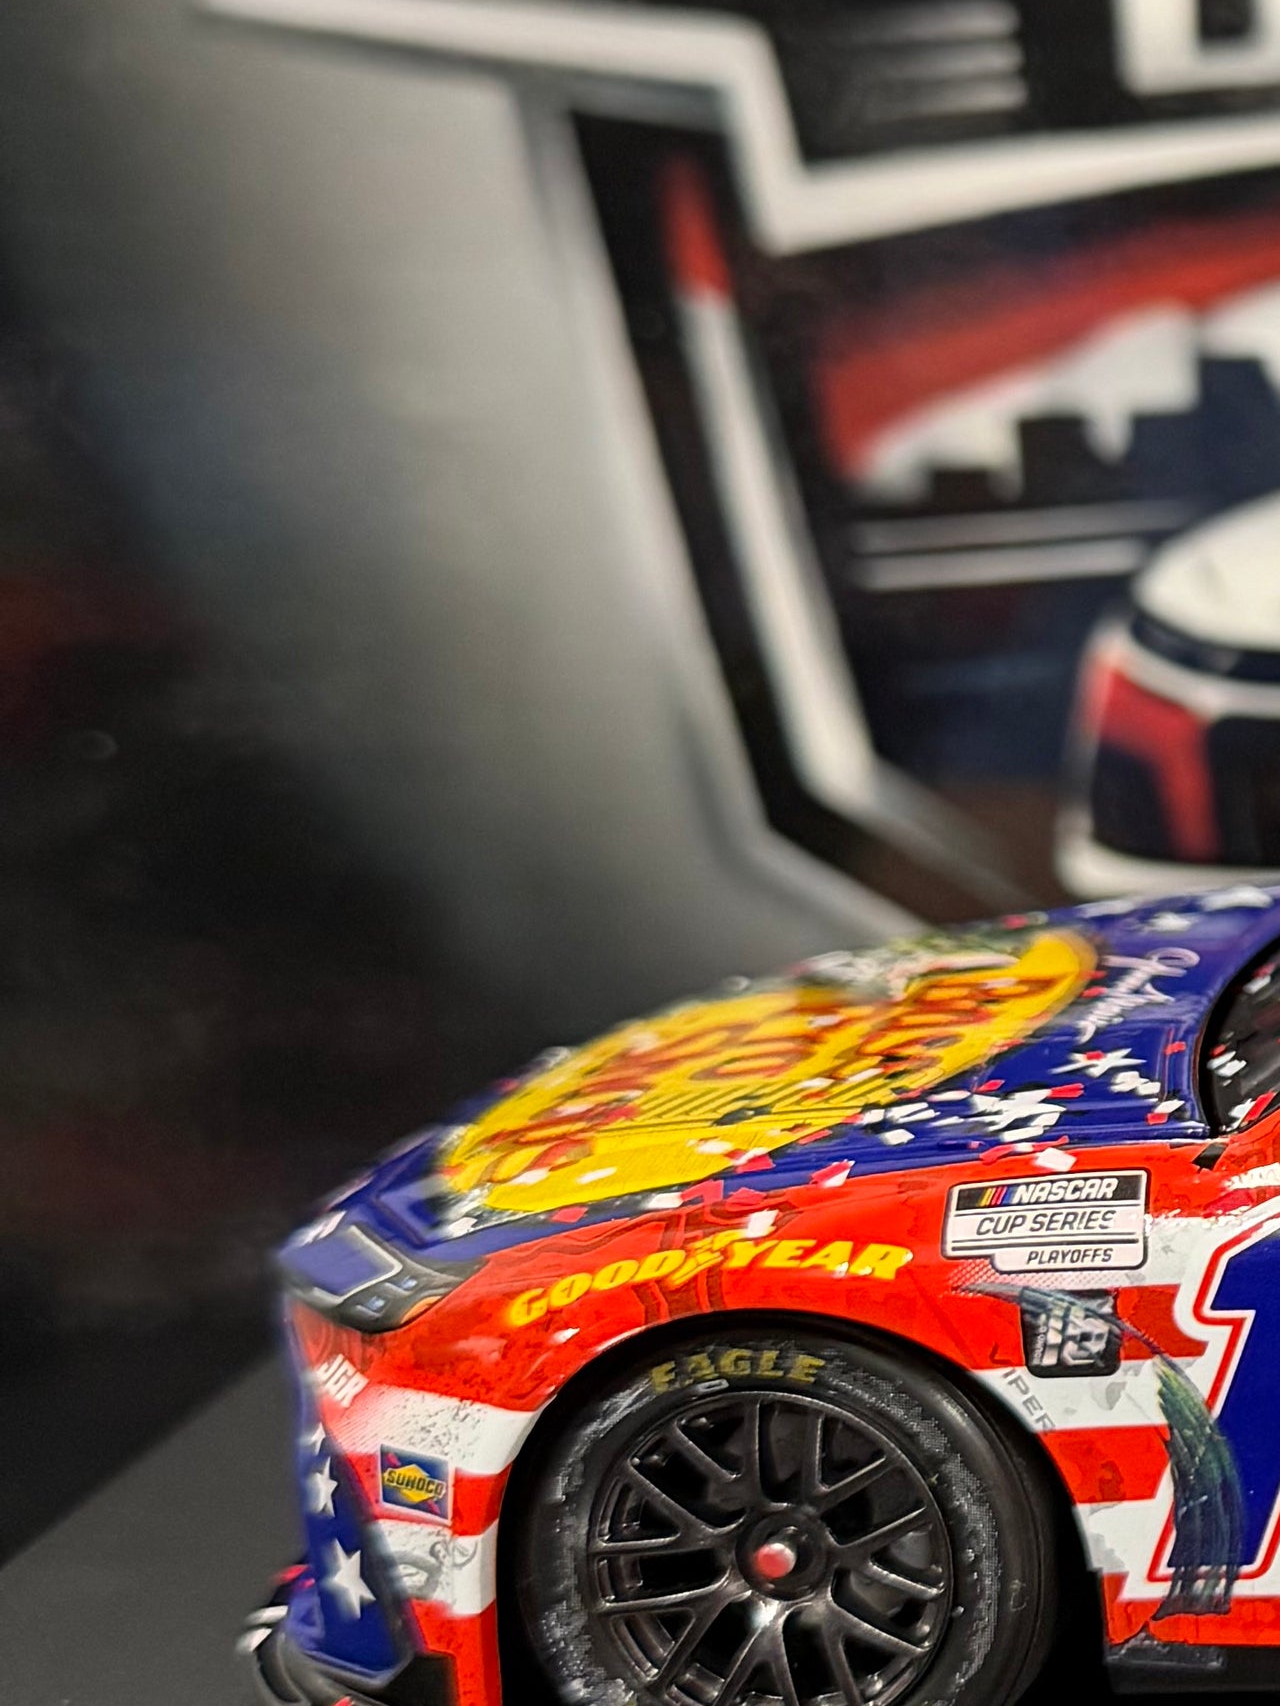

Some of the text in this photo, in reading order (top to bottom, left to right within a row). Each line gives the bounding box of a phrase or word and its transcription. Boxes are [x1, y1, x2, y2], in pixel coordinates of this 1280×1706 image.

[1011, 1177, 1119, 1205] NASCAR
[976, 1209, 1117, 1236] CUP SERIES
[1026, 1247, 1114, 1266] PLAYOFFS
[509, 1231, 914, 1327] GOODYEAR
[315, 1352, 369, 1408] JGR
[650, 1347, 827, 1393] EAGLE
[385, 1467, 446, 1500] SUNOCO
